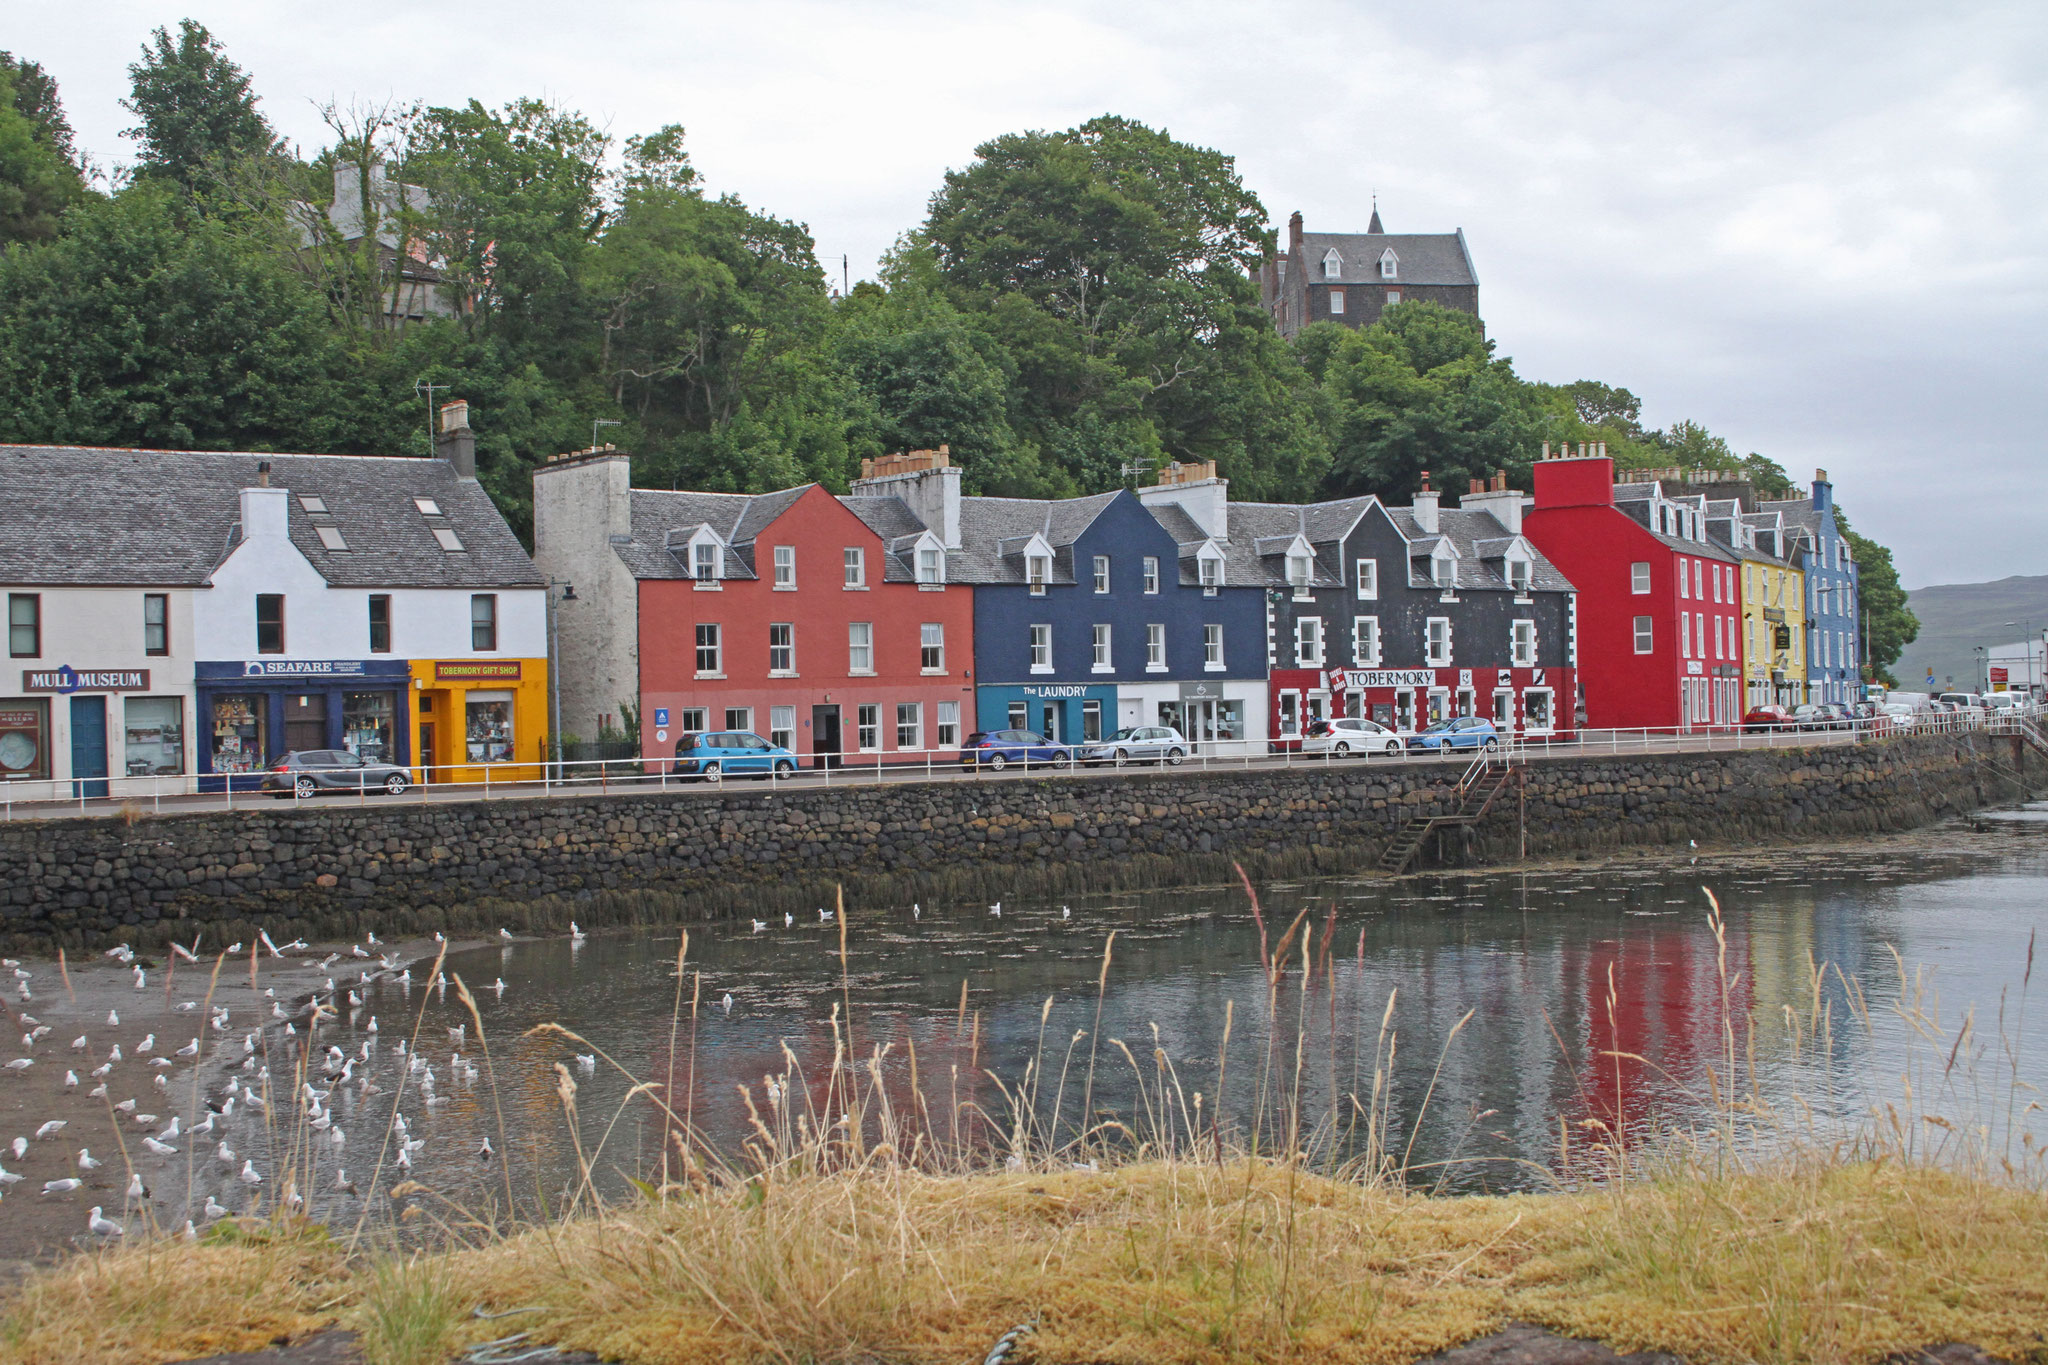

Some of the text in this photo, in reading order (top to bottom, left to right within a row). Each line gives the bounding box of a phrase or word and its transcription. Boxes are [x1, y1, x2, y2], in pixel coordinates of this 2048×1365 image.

[267, 662, 331, 673] SEAFARE
[440, 666, 518, 675] TOBERMORY GIFT SHOP
[31, 672, 143, 688] MULL MUSEUM
[1348, 671, 1433, 686] TOBERMORY
[1023, 686, 1088, 698] The LAUNDRY
